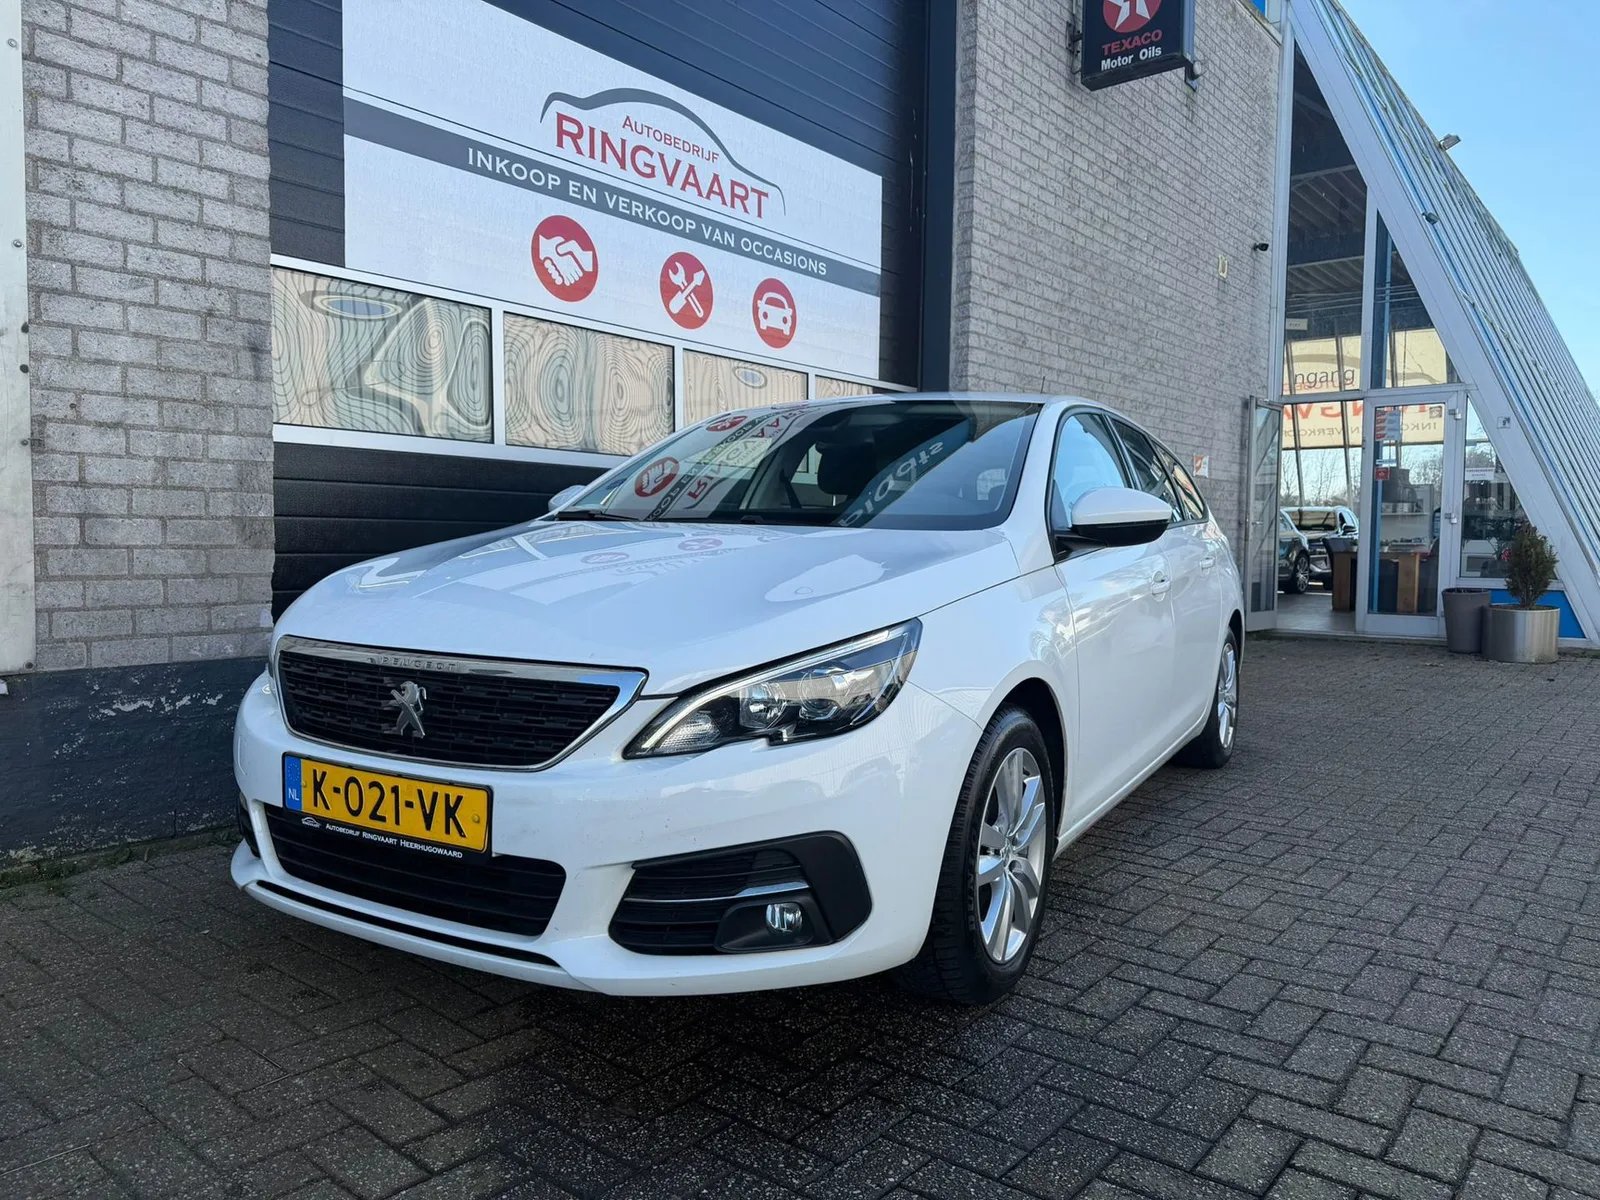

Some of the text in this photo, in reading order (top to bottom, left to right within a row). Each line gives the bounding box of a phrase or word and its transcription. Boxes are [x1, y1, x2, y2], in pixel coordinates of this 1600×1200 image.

[1102, 29, 1163, 56] TEXACO
[1101, 46, 1162, 71] Motor Oils
[622, 115, 719, 163] AUTOBEDRIJF
[555, 111, 769, 219] RINGVAART
[468, 147, 828, 276] INKOOP EN VERKOOP VAN OCCASIONS
[1290, 368, 1355, 389] ngang
[382, 656, 456, 671] PEUGEOT
[288, 787, 300, 801] NL
[312, 768, 467, 838] K-021-VK
[325, 823, 361, 837] AUTOBEDRIJF
[362, 831, 398, 845] RINGVAART
[400, 839, 463, 859] HEERHUGOWAARD
